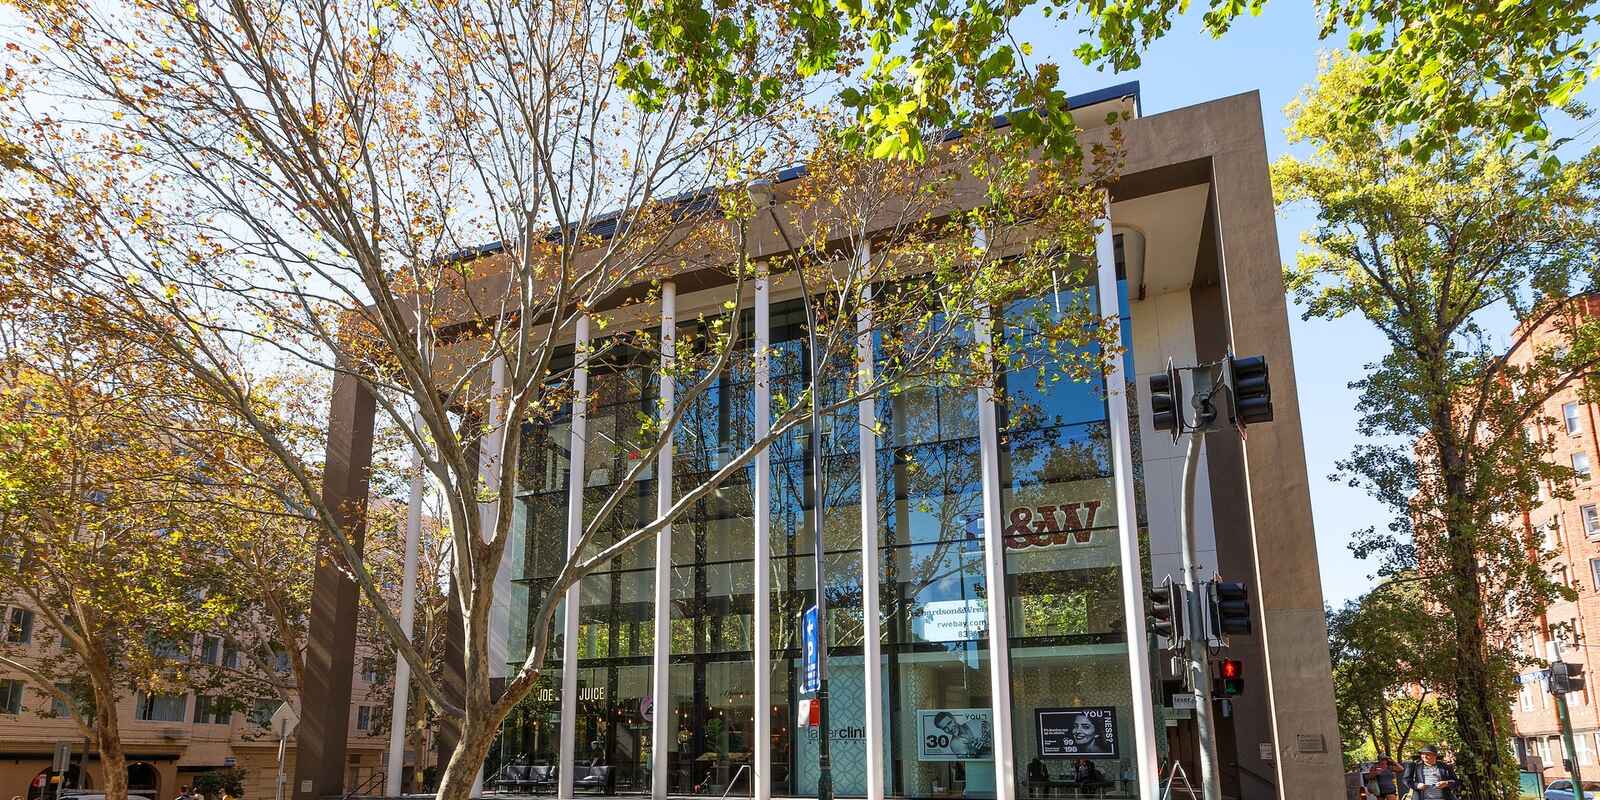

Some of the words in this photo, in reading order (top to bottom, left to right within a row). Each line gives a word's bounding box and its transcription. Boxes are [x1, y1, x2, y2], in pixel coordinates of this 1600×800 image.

[537, 688, 554, 702] JOE
[578, 687, 605, 701] JUICE
[1083, 710, 1103, 718] YOU
[808, 726, 866, 739] laerclini
[1104, 717, 1114, 743] NESS?
[926, 734, 949, 748] 30
